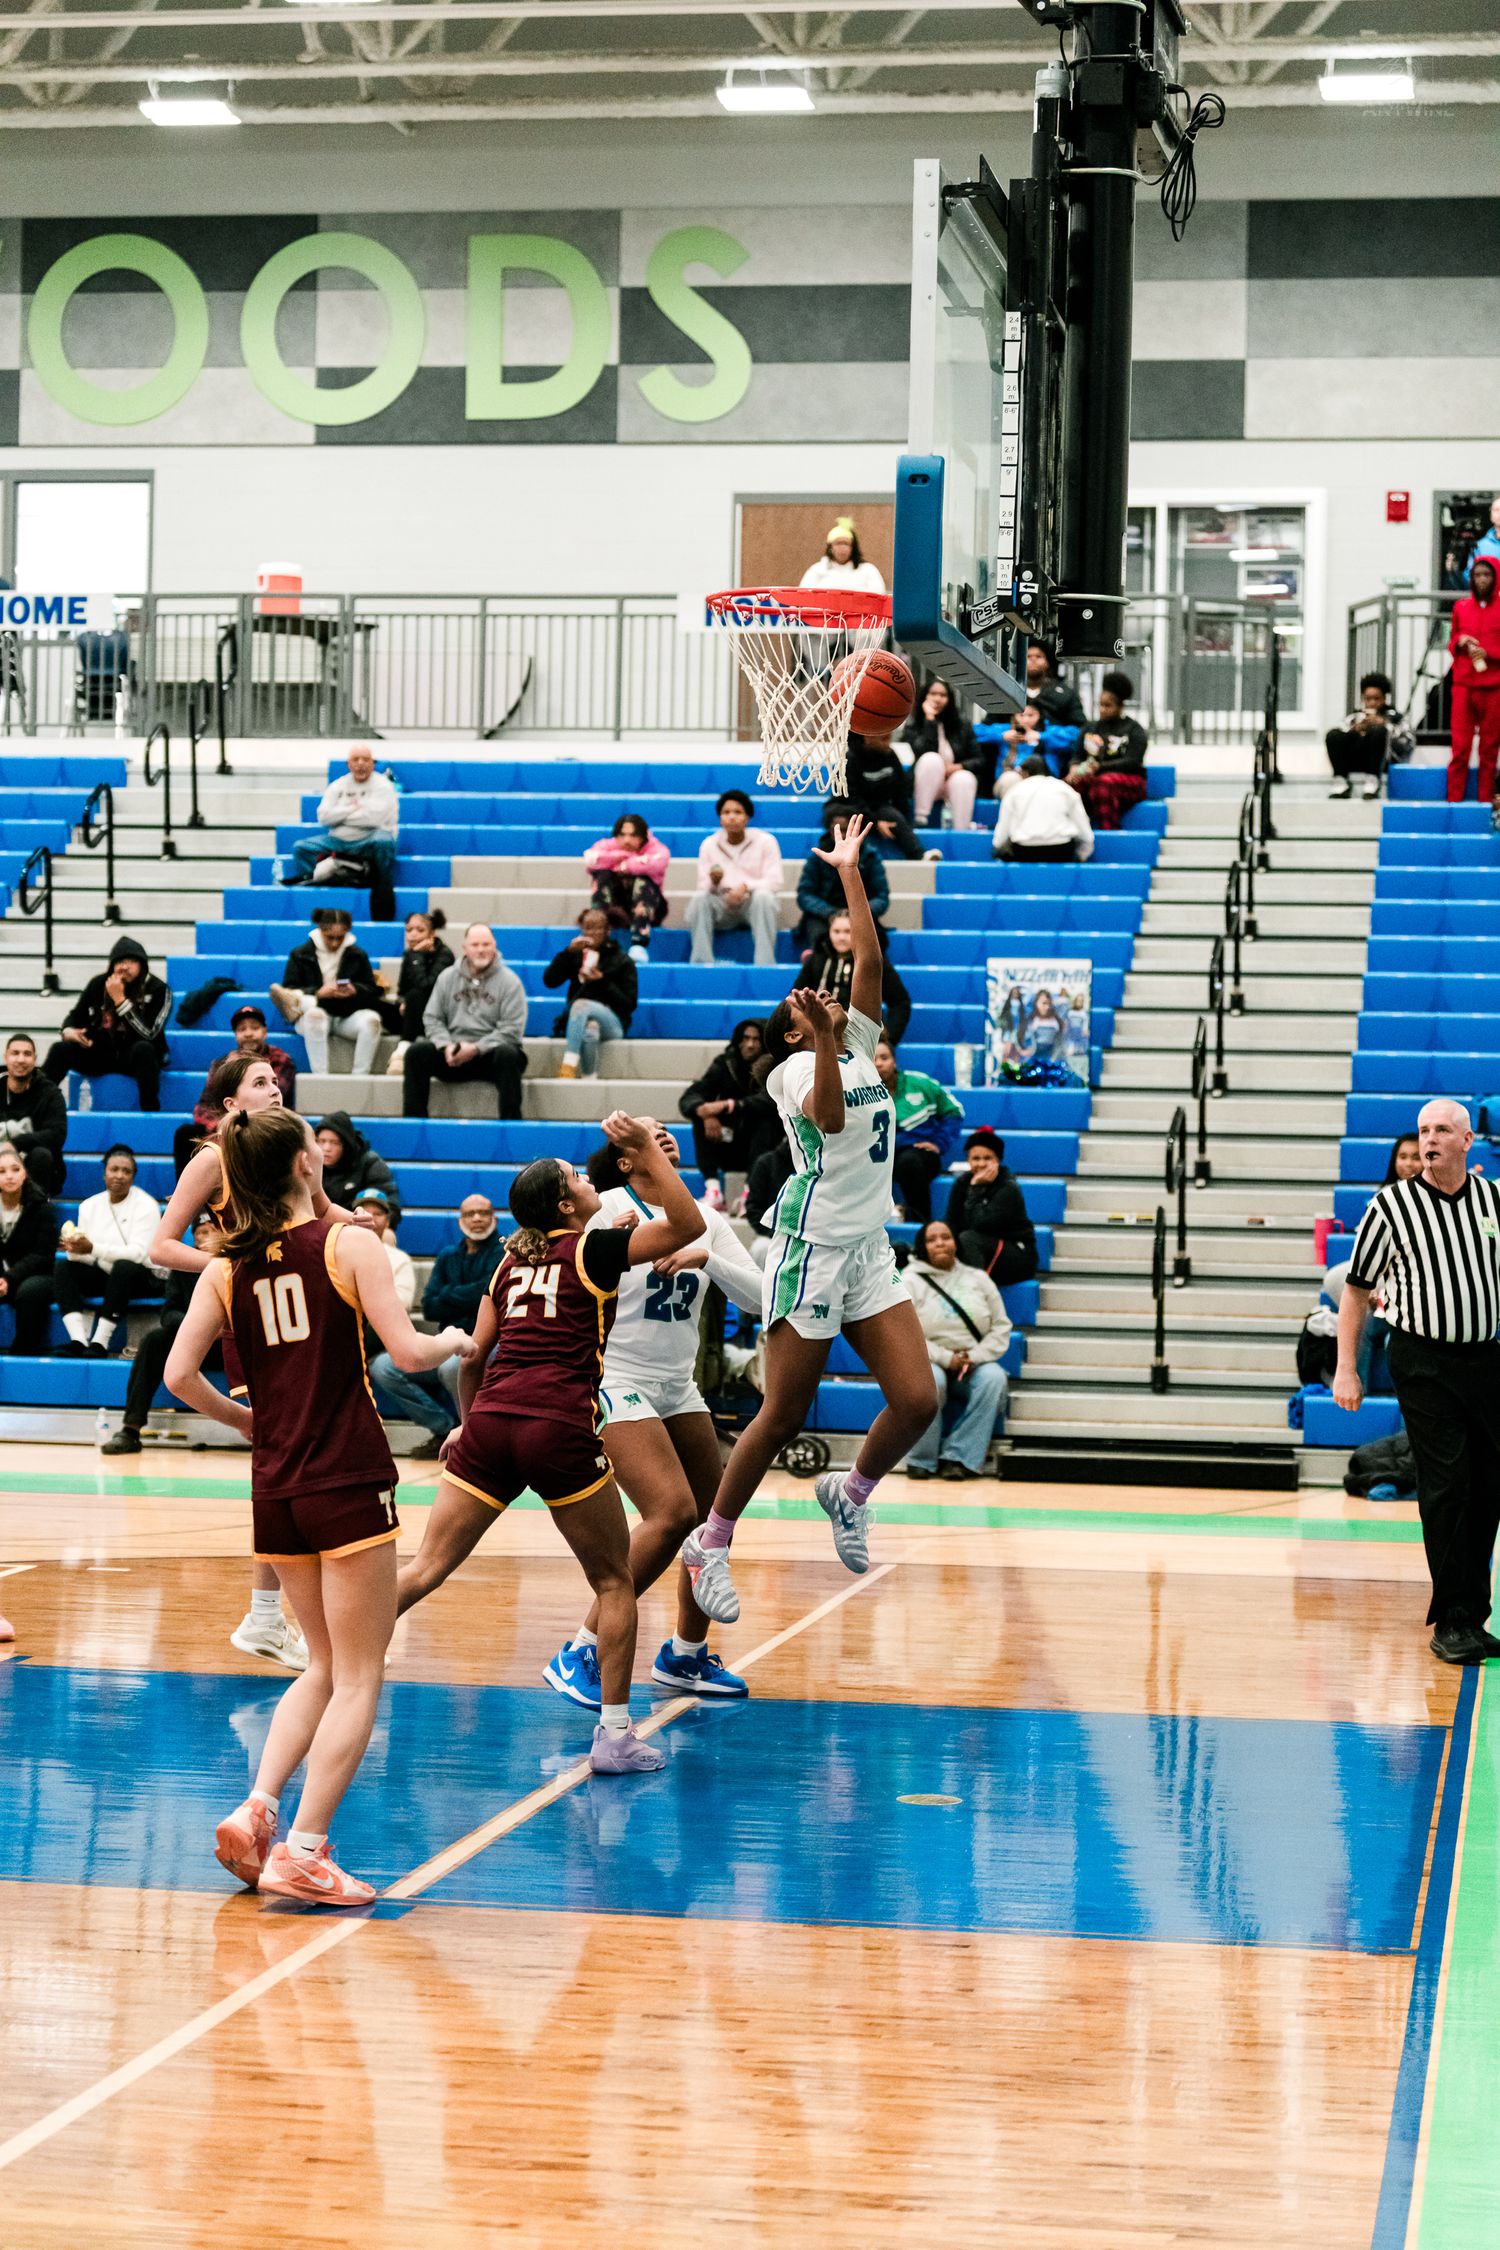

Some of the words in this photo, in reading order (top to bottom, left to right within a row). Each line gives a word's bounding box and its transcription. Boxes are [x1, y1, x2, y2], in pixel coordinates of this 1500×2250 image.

[0, 225, 753, 426] OODS
[0, 596, 88, 624] OME
[843, 1081, 888, 1108] WARRIO
[869, 1109, 890, 1164] 3
[252, 1272, 311, 1347] 10
[505, 1263, 562, 1319] 24
[643, 1269, 700, 1323] 23
[378, 1489, 394, 1526] T
